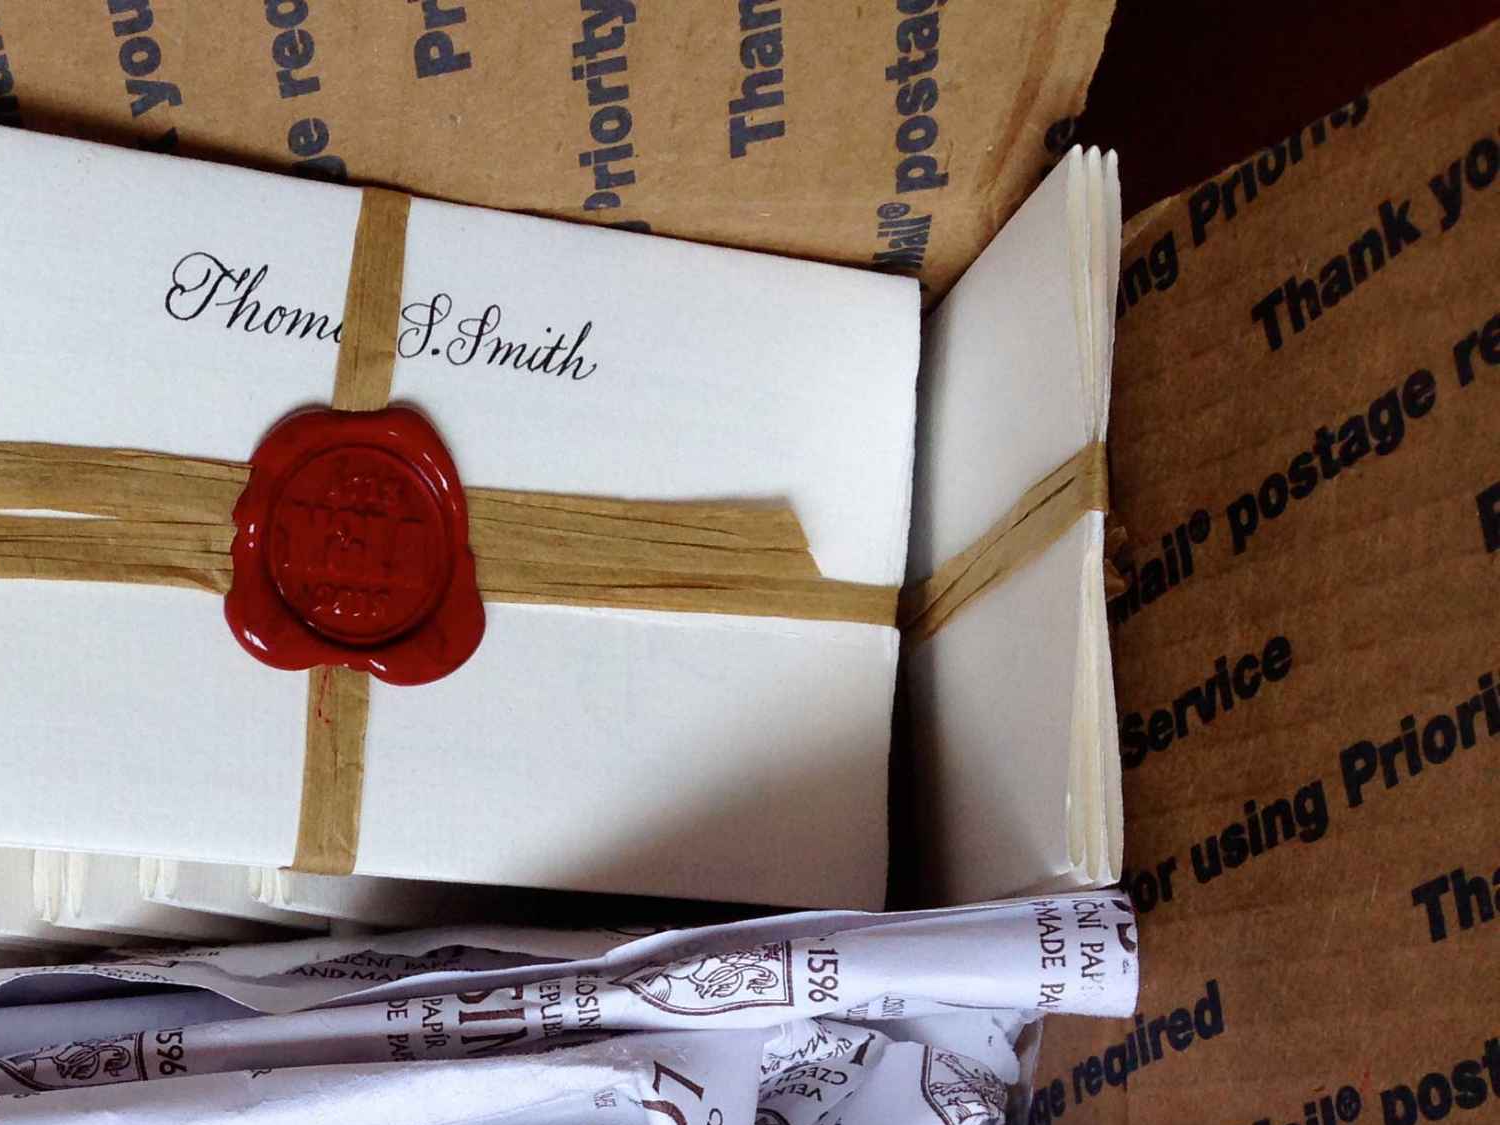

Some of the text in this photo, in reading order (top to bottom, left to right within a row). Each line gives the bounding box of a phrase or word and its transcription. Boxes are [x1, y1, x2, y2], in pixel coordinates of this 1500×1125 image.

[107, 0, 183, 117] you
[728, 0, 787, 159] Than
[886, 0, 950, 194] posta
[164, 251, 345, 345] Thom
[1251, 199, 1421, 352] Thank
[1429, 126, 1500, 232] yo
[1227, 369, 1436, 555] postage
[1119, 636, 1292, 770] Service
[1190, 780, 1329, 884] using
[1339, 671, 1500, 808] Priori
[808, 947, 839, 1003] 1596
[1072, 978, 1225, 1106] required
